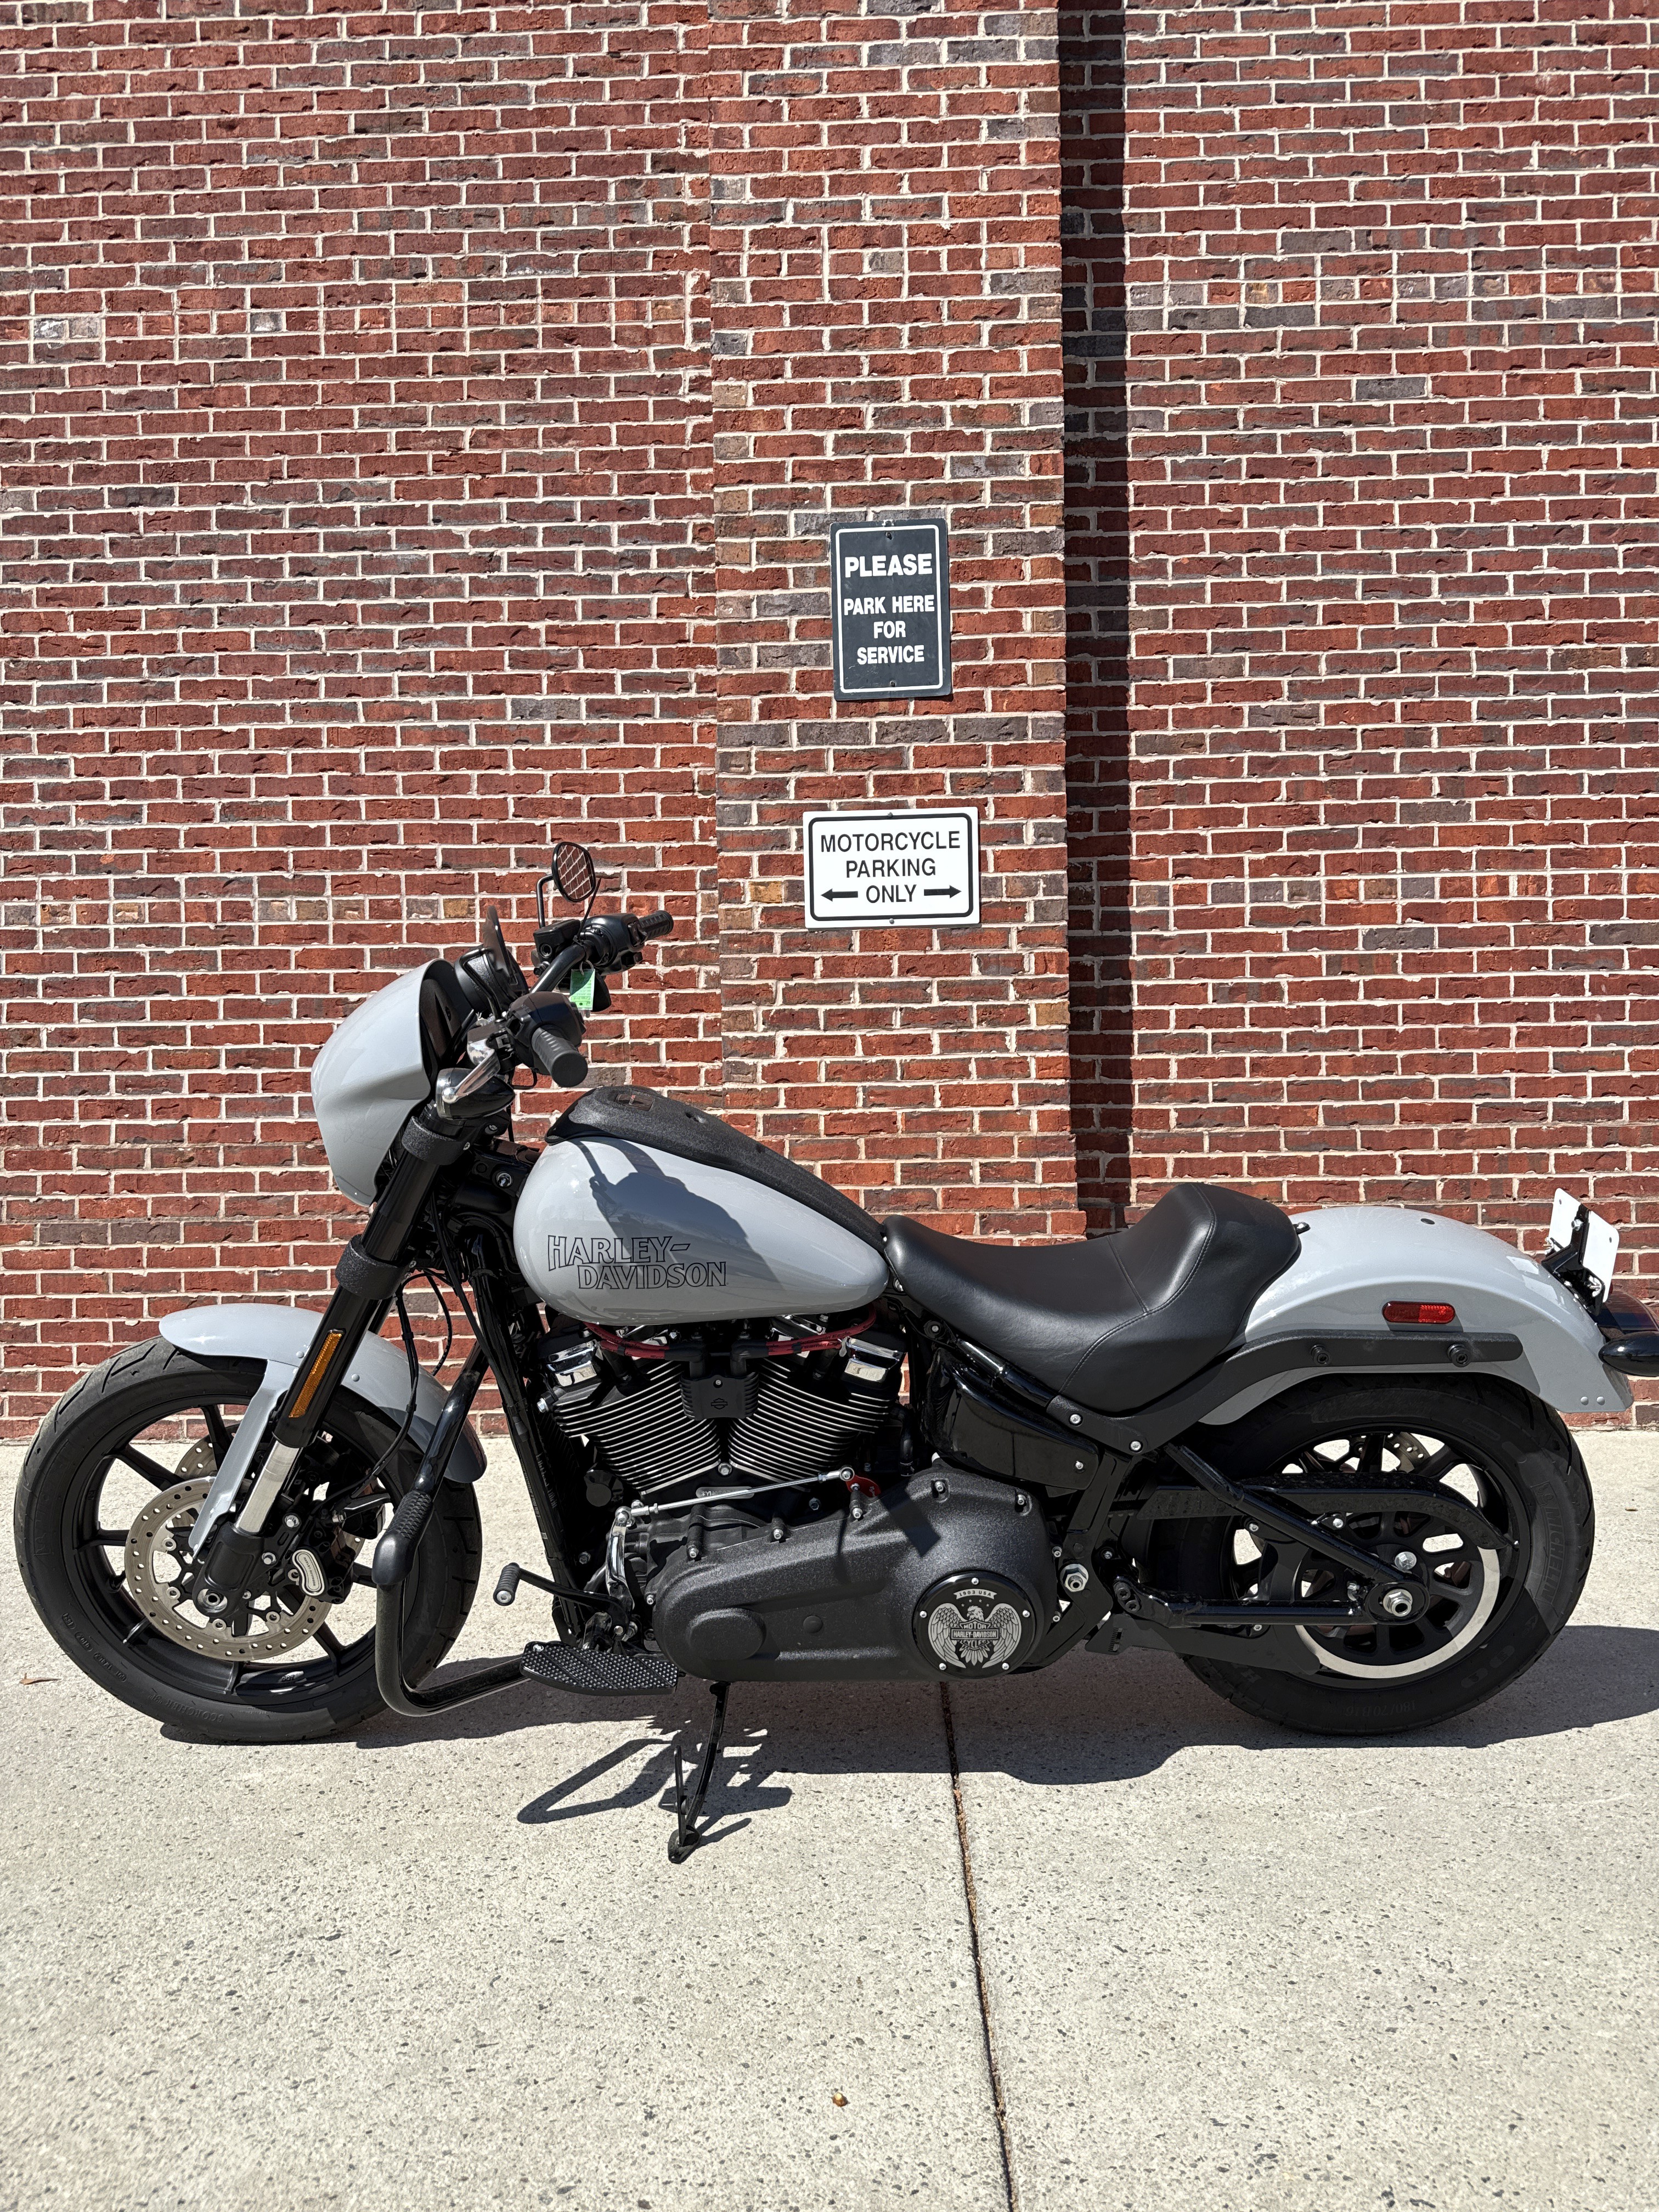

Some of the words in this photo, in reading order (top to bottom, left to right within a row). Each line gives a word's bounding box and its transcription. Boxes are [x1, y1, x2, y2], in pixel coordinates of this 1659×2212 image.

[845, 553, 932, 578] PLEASE
[844, 596, 886, 616] PARK
[892, 594, 935, 613] HERE
[873, 620, 906, 639] FOR
[857, 645, 924, 665] SERVICE
[821, 831, 960, 853] MOTORCYCLE
[846, 857, 936, 878] PARKING
[866, 884, 917, 904] ONLY
[548, 1234, 691, 1272] HARLEY-
[577, 1261, 726, 1290] DAVIDSON
[963, 1621, 987, 1629] MOTOR
